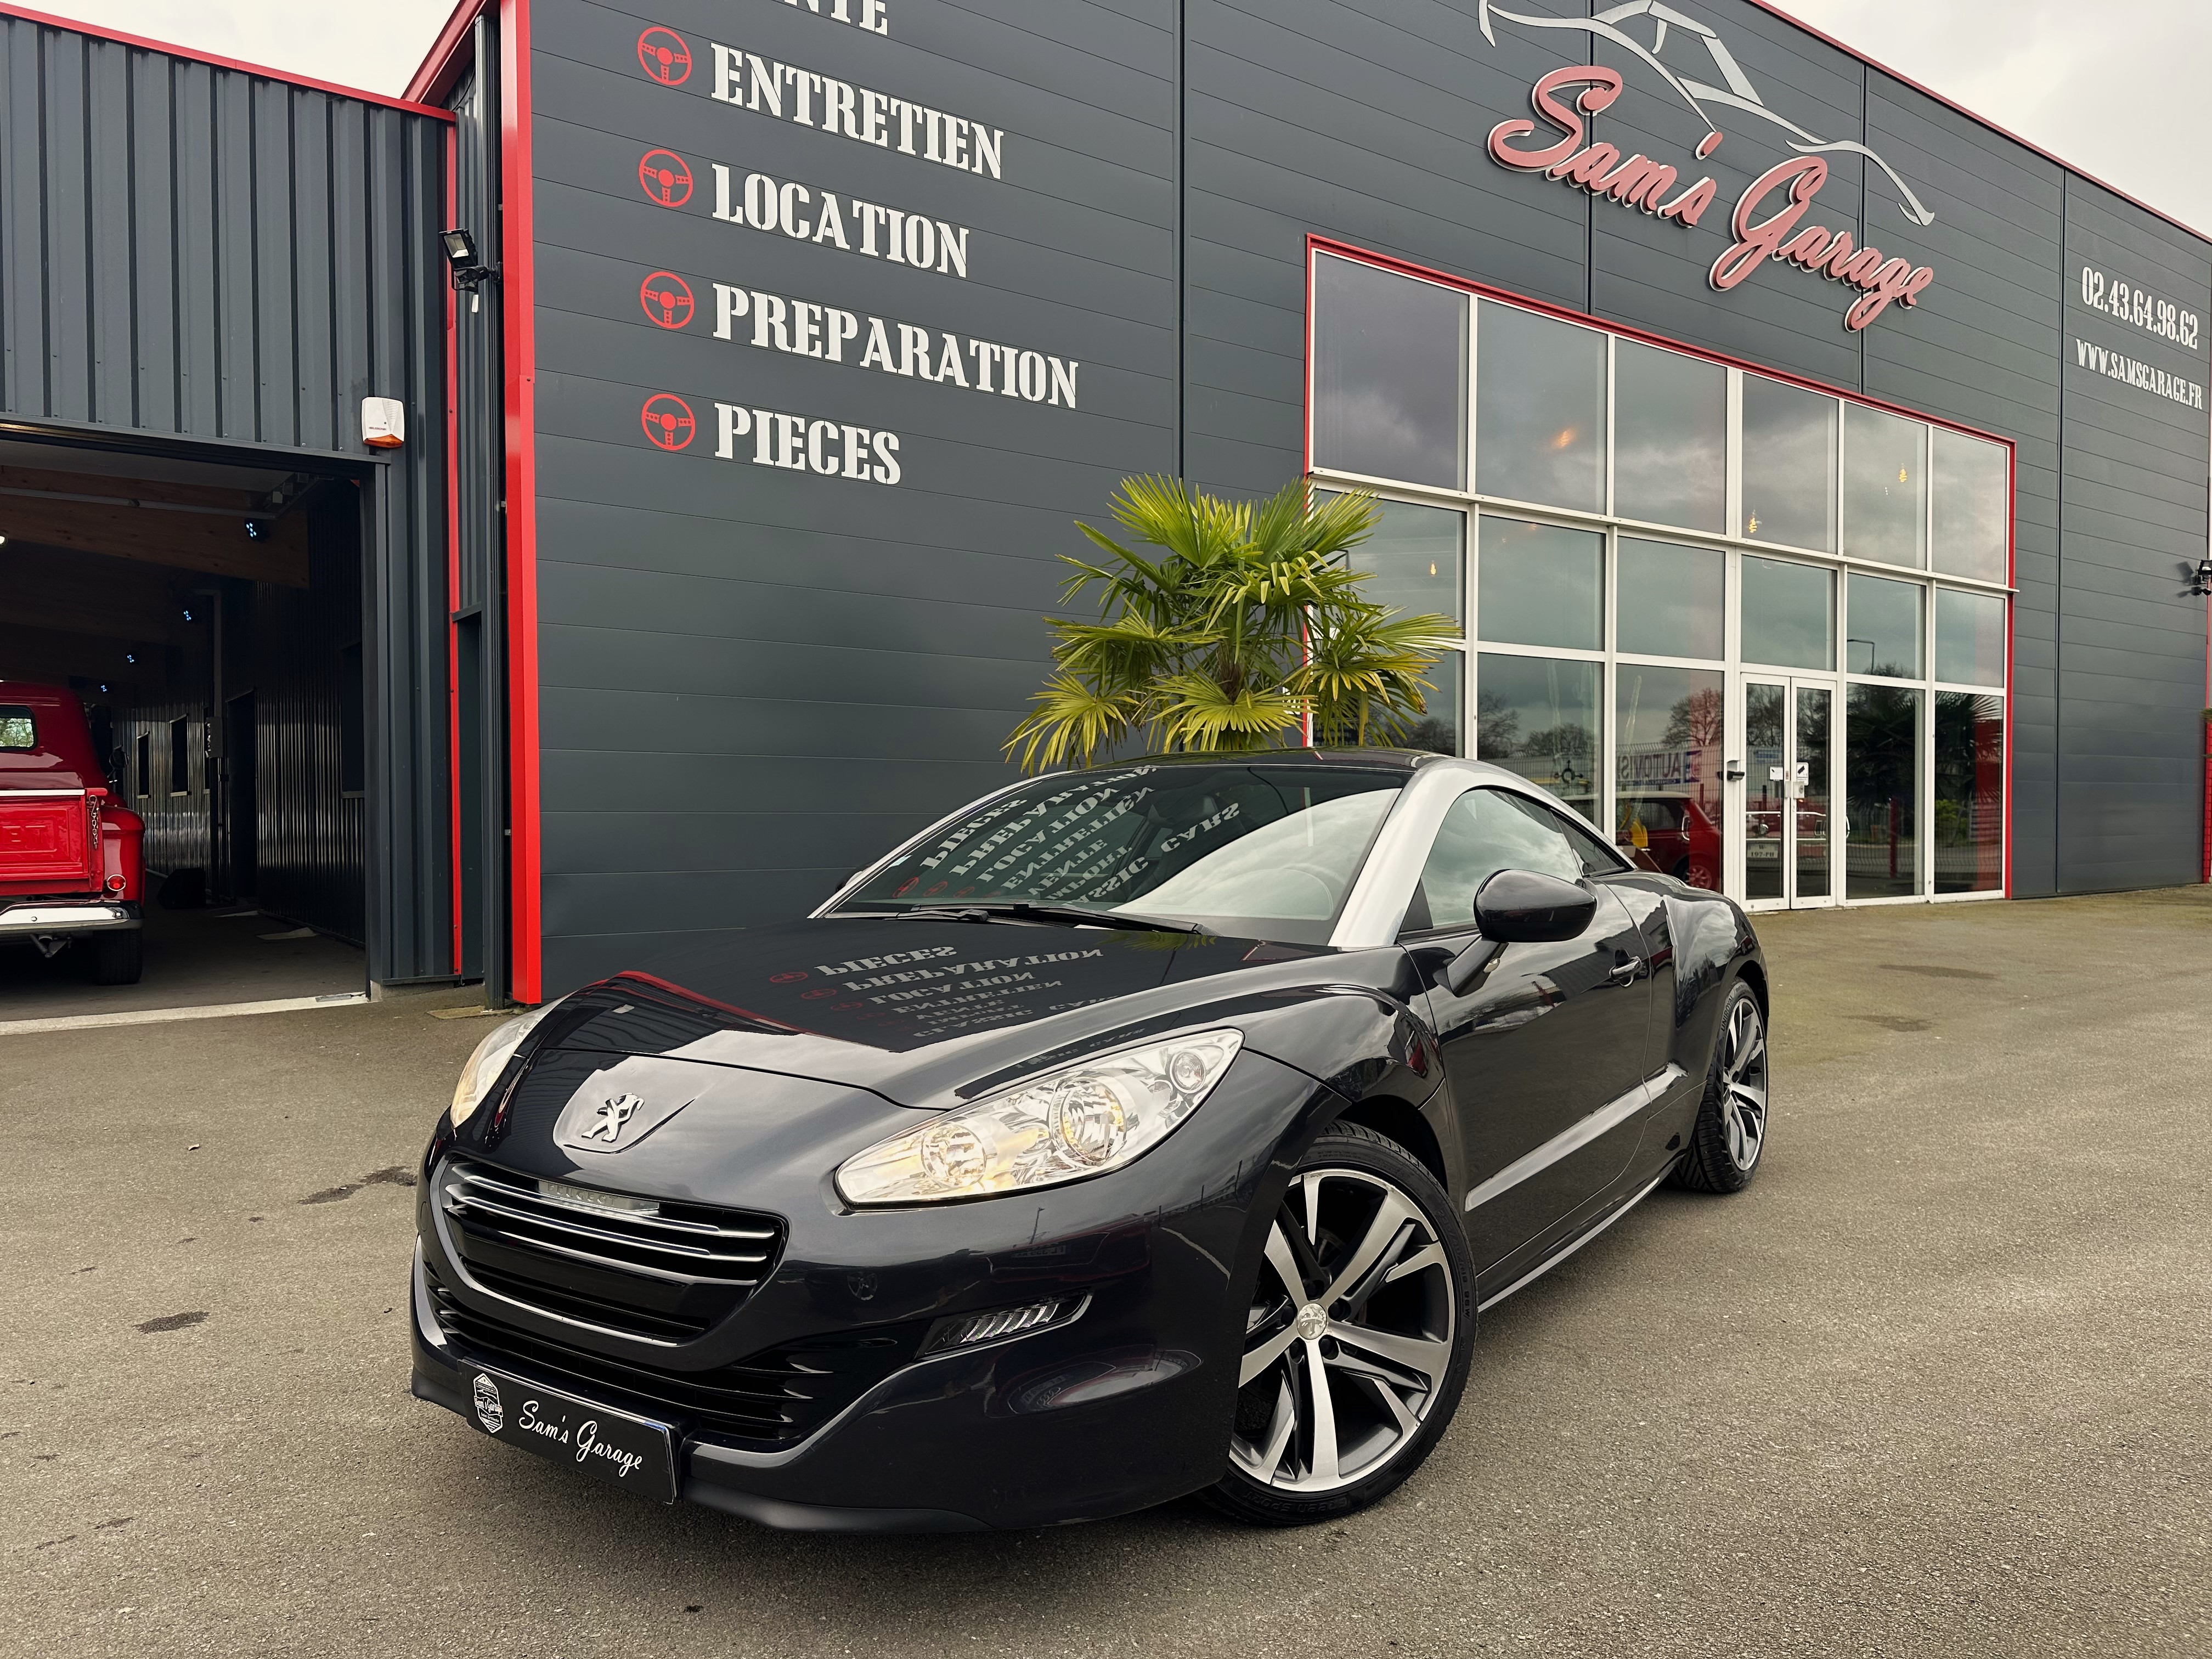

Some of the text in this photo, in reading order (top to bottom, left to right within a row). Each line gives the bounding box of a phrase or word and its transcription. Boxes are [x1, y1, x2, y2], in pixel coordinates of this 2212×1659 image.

[710, 42, 1004, 180] ENTRETIEN
[712, 162, 969, 278] LOCATION
[1487, 65, 1933, 333] Sam's Garage
[713, 283, 1079, 409] PREPARATION
[2081, 266, 2198, 349] 02.43.64.98.62
[2076, 338, 2202, 410] WWW.SAMSGARAGE.FR
[714, 402, 901, 485] PIECES
[1720, 995, 1734, 1032] UNIROYAL
[548, 1183, 618, 1206] PEUGEOT
[518, 1400, 642, 1477] Sam's Garage
